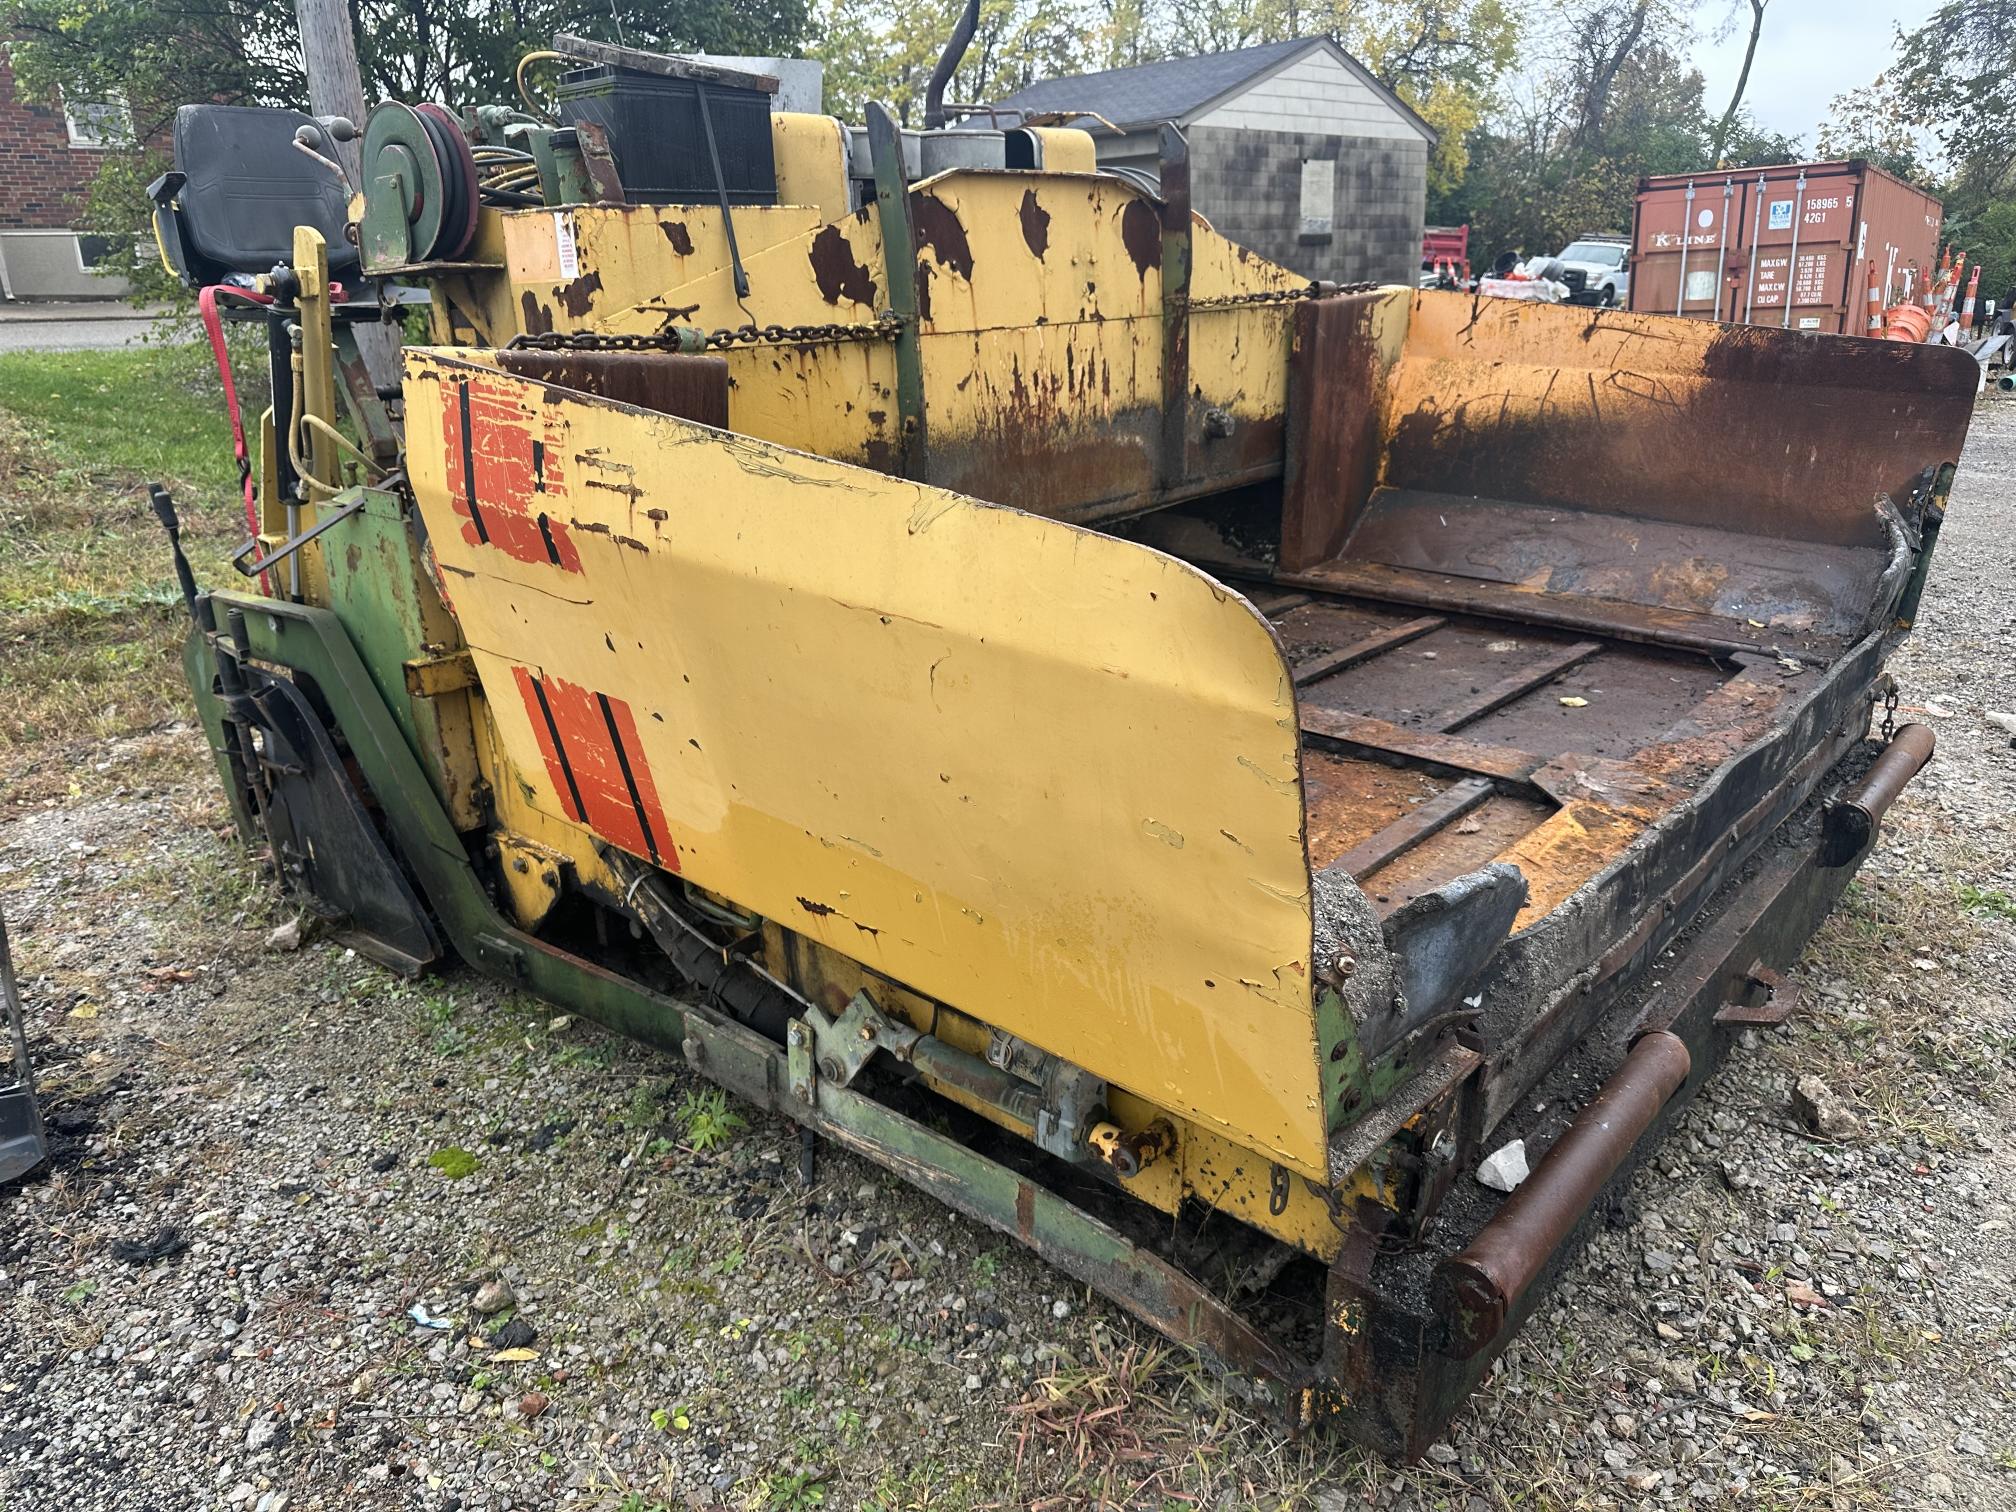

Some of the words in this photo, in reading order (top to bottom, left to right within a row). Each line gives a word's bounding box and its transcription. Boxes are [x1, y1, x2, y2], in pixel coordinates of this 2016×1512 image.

[1806, 197, 1838, 210] 158965
[1845, 195, 1853, 208] 5
[1804, 212, 1826, 224] 42G1
[1760, 271, 1775, 280] TARE
